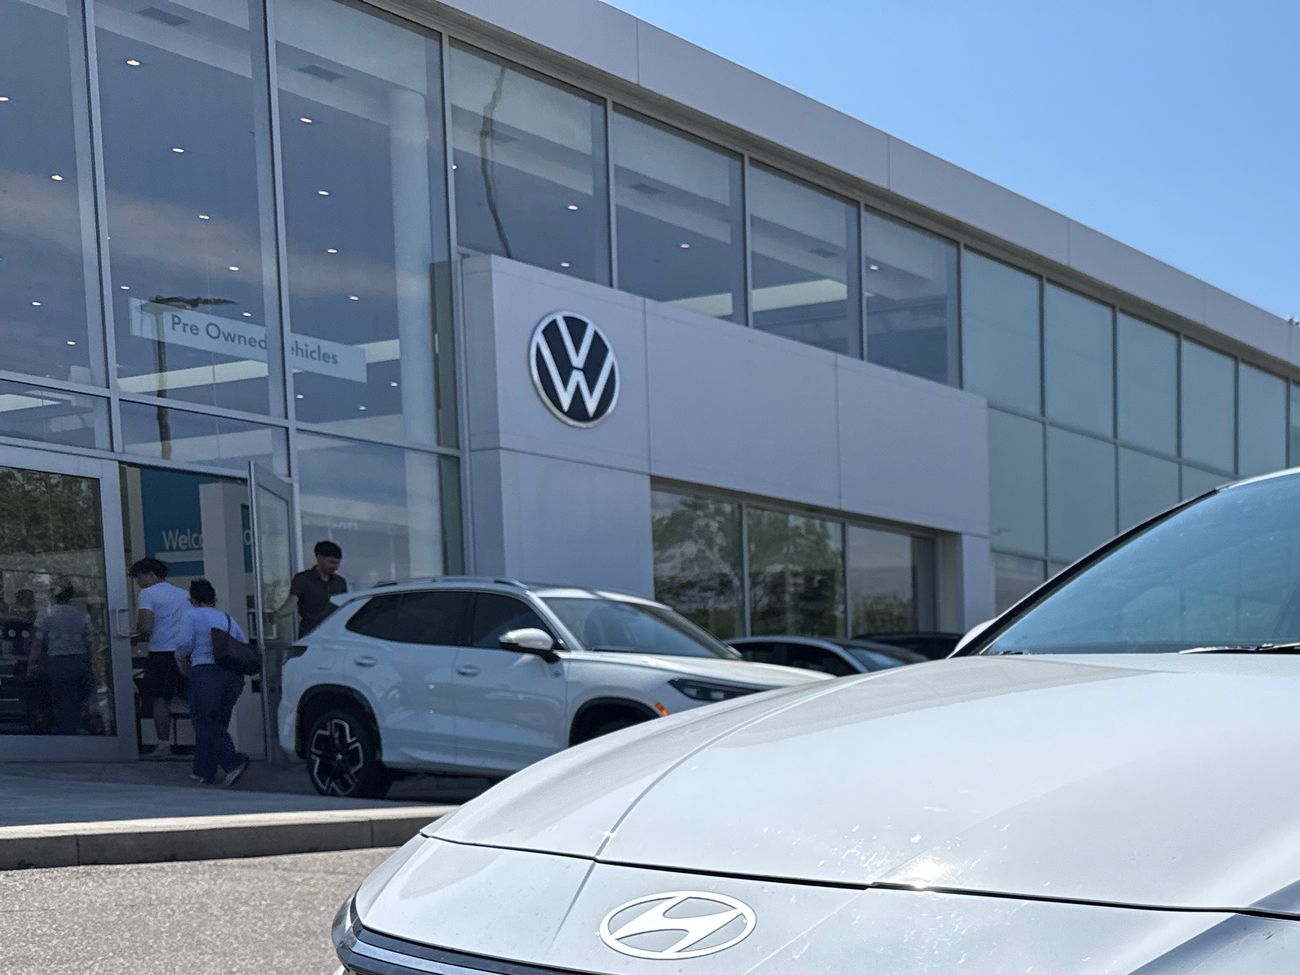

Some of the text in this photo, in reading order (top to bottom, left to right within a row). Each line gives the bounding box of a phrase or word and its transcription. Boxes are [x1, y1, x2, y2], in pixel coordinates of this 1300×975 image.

[171, 314, 339, 365] Pre Owned hicles
[531, 311, 619, 424] VW
